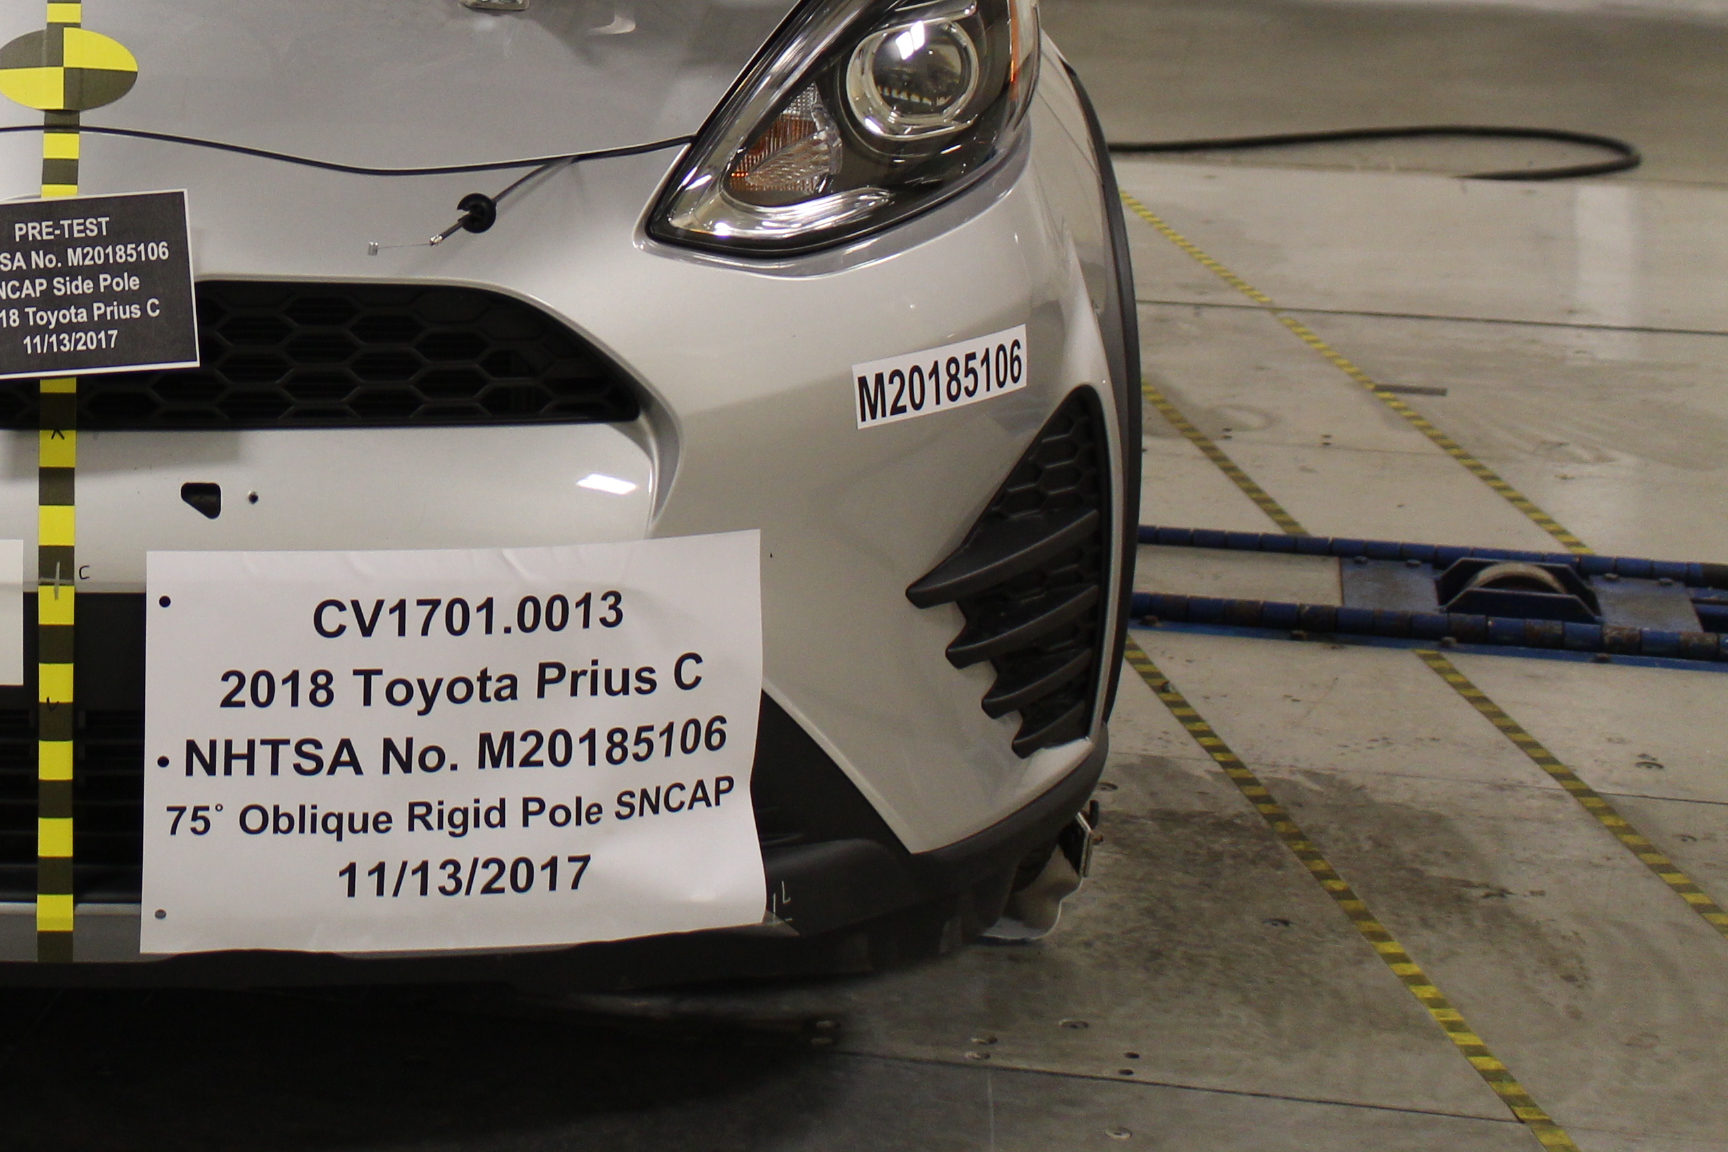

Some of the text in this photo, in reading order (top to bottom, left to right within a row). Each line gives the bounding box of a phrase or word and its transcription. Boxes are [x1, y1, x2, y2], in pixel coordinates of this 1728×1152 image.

[14, 216, 110, 242] PRE-TEST
[31, 250, 62, 269] No.
[67, 241, 170, 267] M20185106
[53, 276, 94, 296] Side
[99, 272, 140, 293] Pole
[24, 305, 87, 329] Toyota
[93, 300, 141, 322] Prius
[146, 298, 161, 318] C
[23, 330, 118, 354] 11/13/2017
[857, 338, 1023, 423] M20185106
[313, 590, 625, 639] CV1701.0013
[219, 651, 704, 716] 2018 Toyota Prius C
[184, 714, 728, 778] NHTSA No. M20185106
[238, 801, 393, 842] Oblique
[407, 798, 506, 837] Rigid
[521, 795, 604, 828] Pole
[614, 774, 736, 820] SNCAP
[337, 854, 593, 898] 11/13/2017
